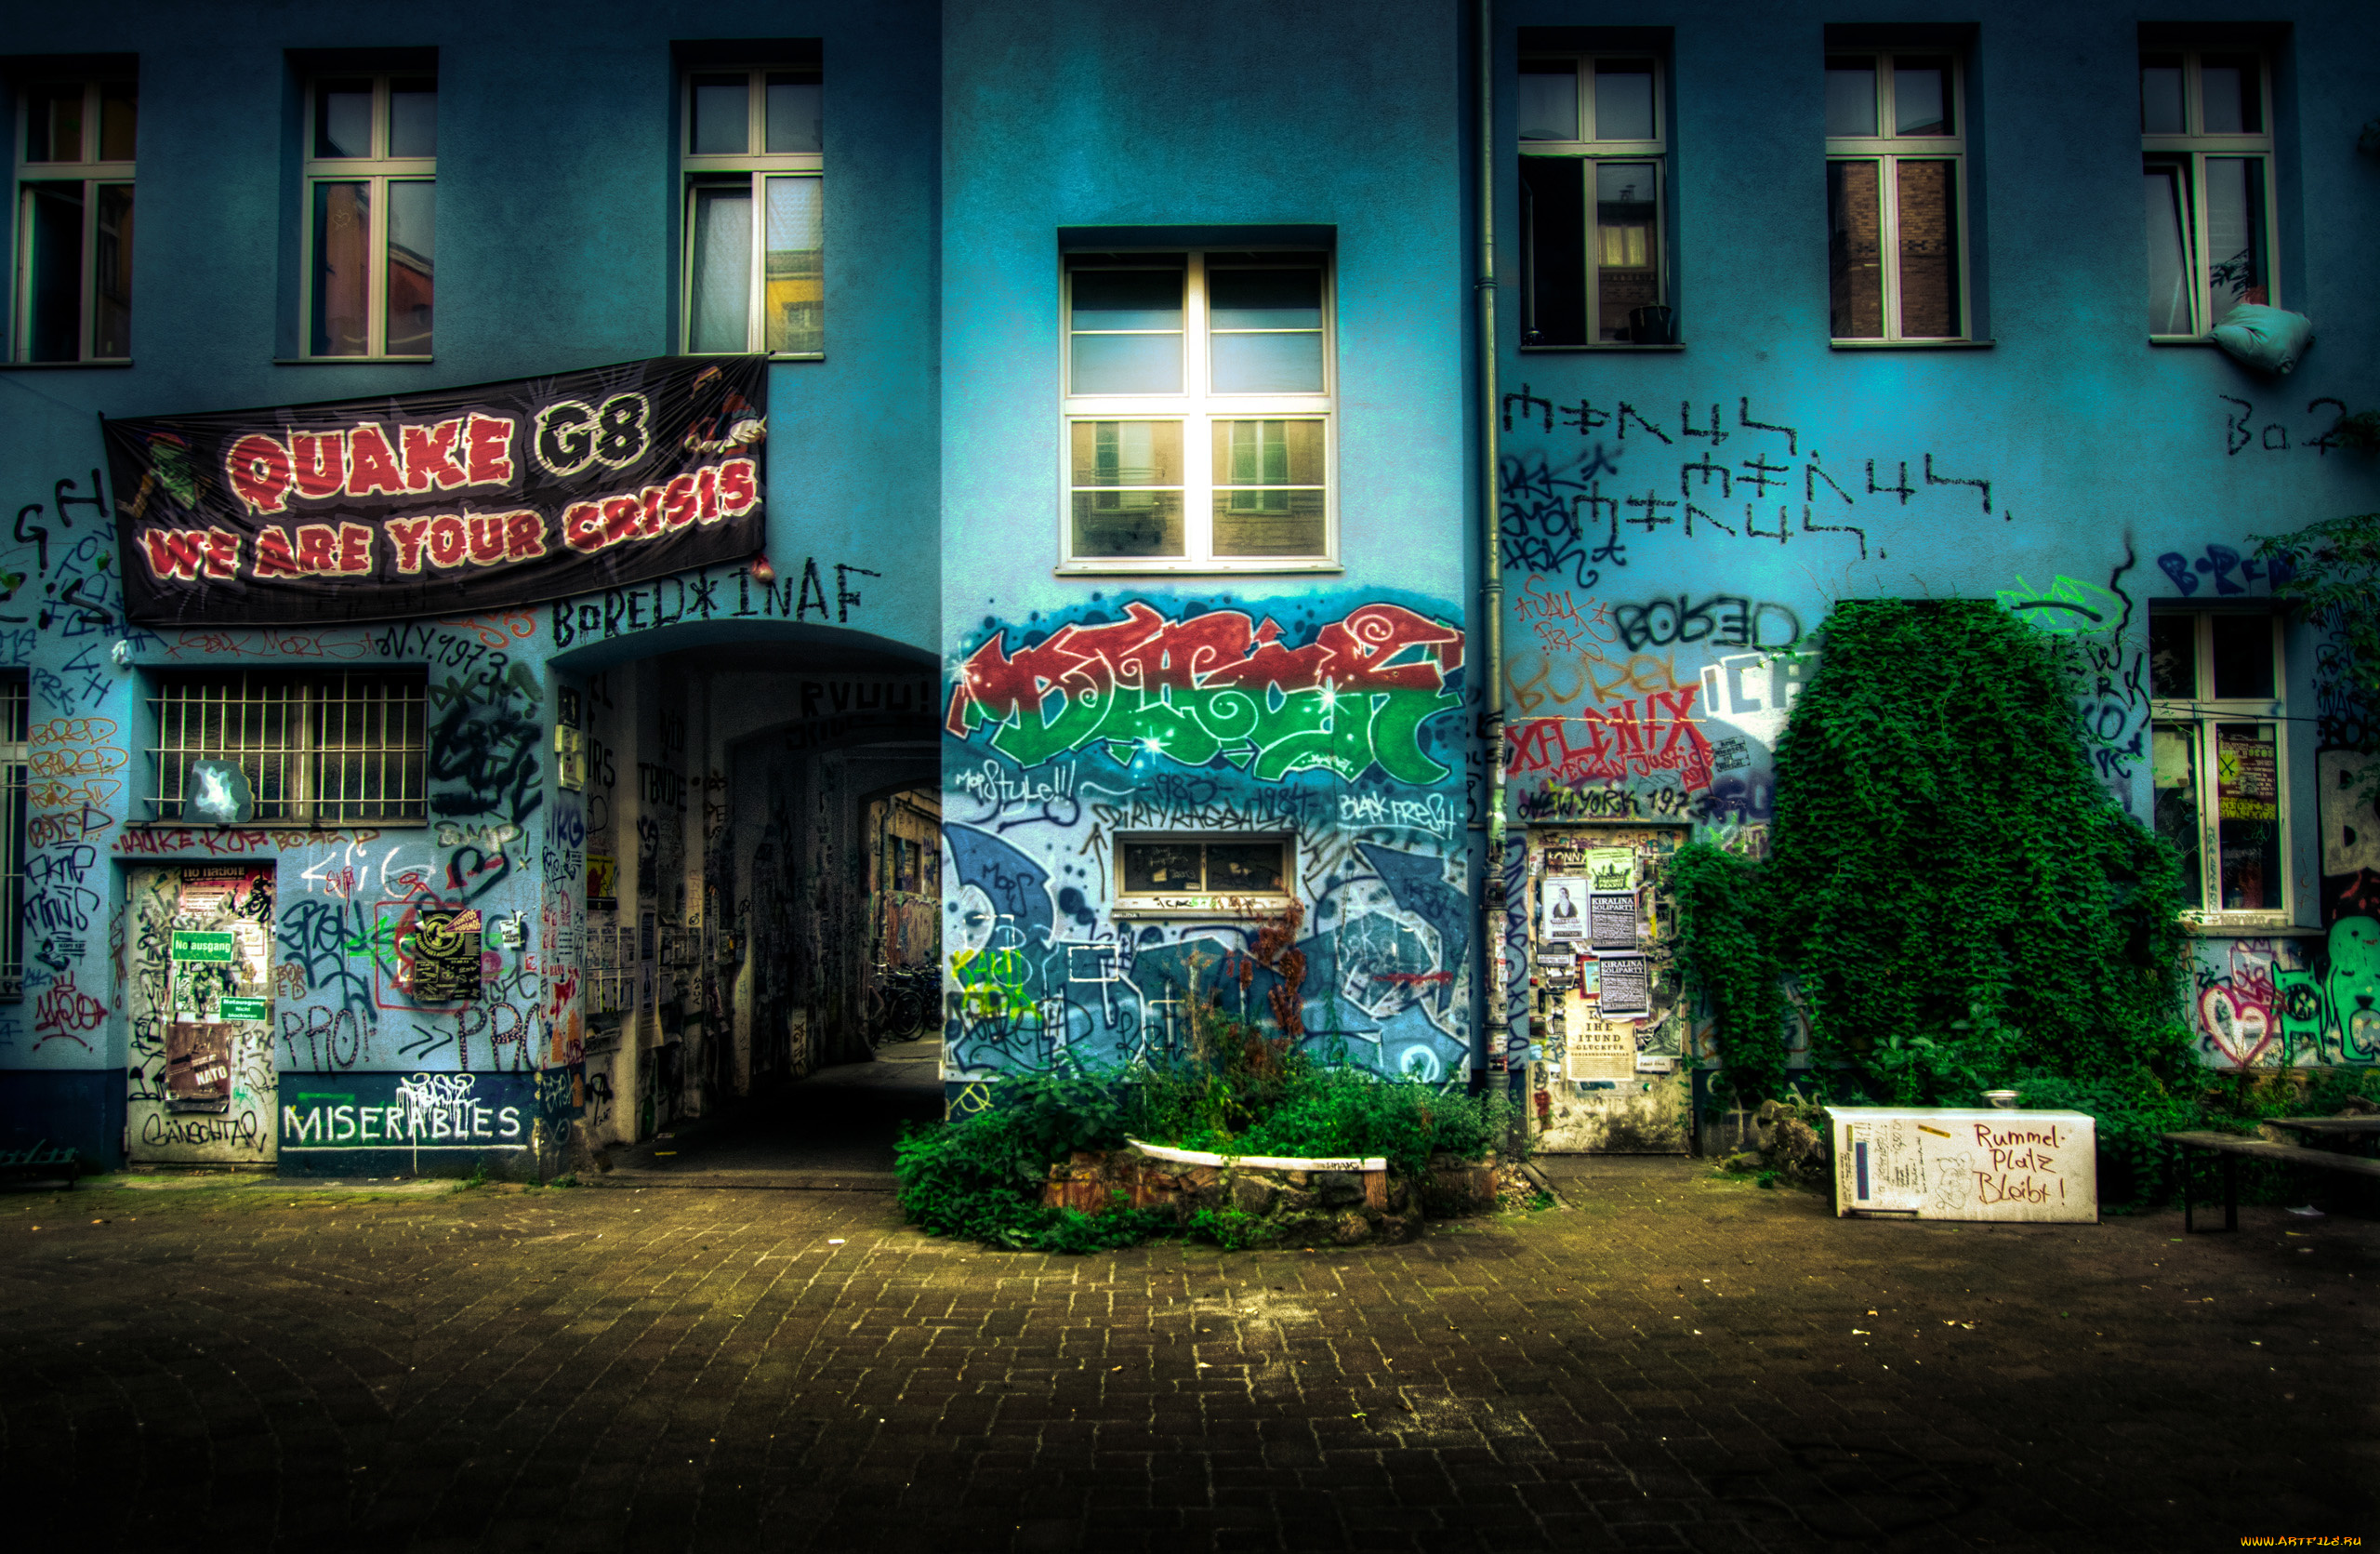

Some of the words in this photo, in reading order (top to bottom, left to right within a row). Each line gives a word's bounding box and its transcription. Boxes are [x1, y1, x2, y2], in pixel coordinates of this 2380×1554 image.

[225, 413, 515, 517] QUAKE
[534, 392, 652, 478] G8
[137, 525, 241, 581] WE
[253, 525, 374, 580] ARE
[387, 508, 549, 573] YOUR
[562, 458, 760, 555] CRISIS
[223, 998, 265, 1007] Notausgang
[195, 1065, 228, 1086] NATO
[283, 1105, 521, 1141] MISERABLES
[1989, 1148, 2056, 1174] Platz
